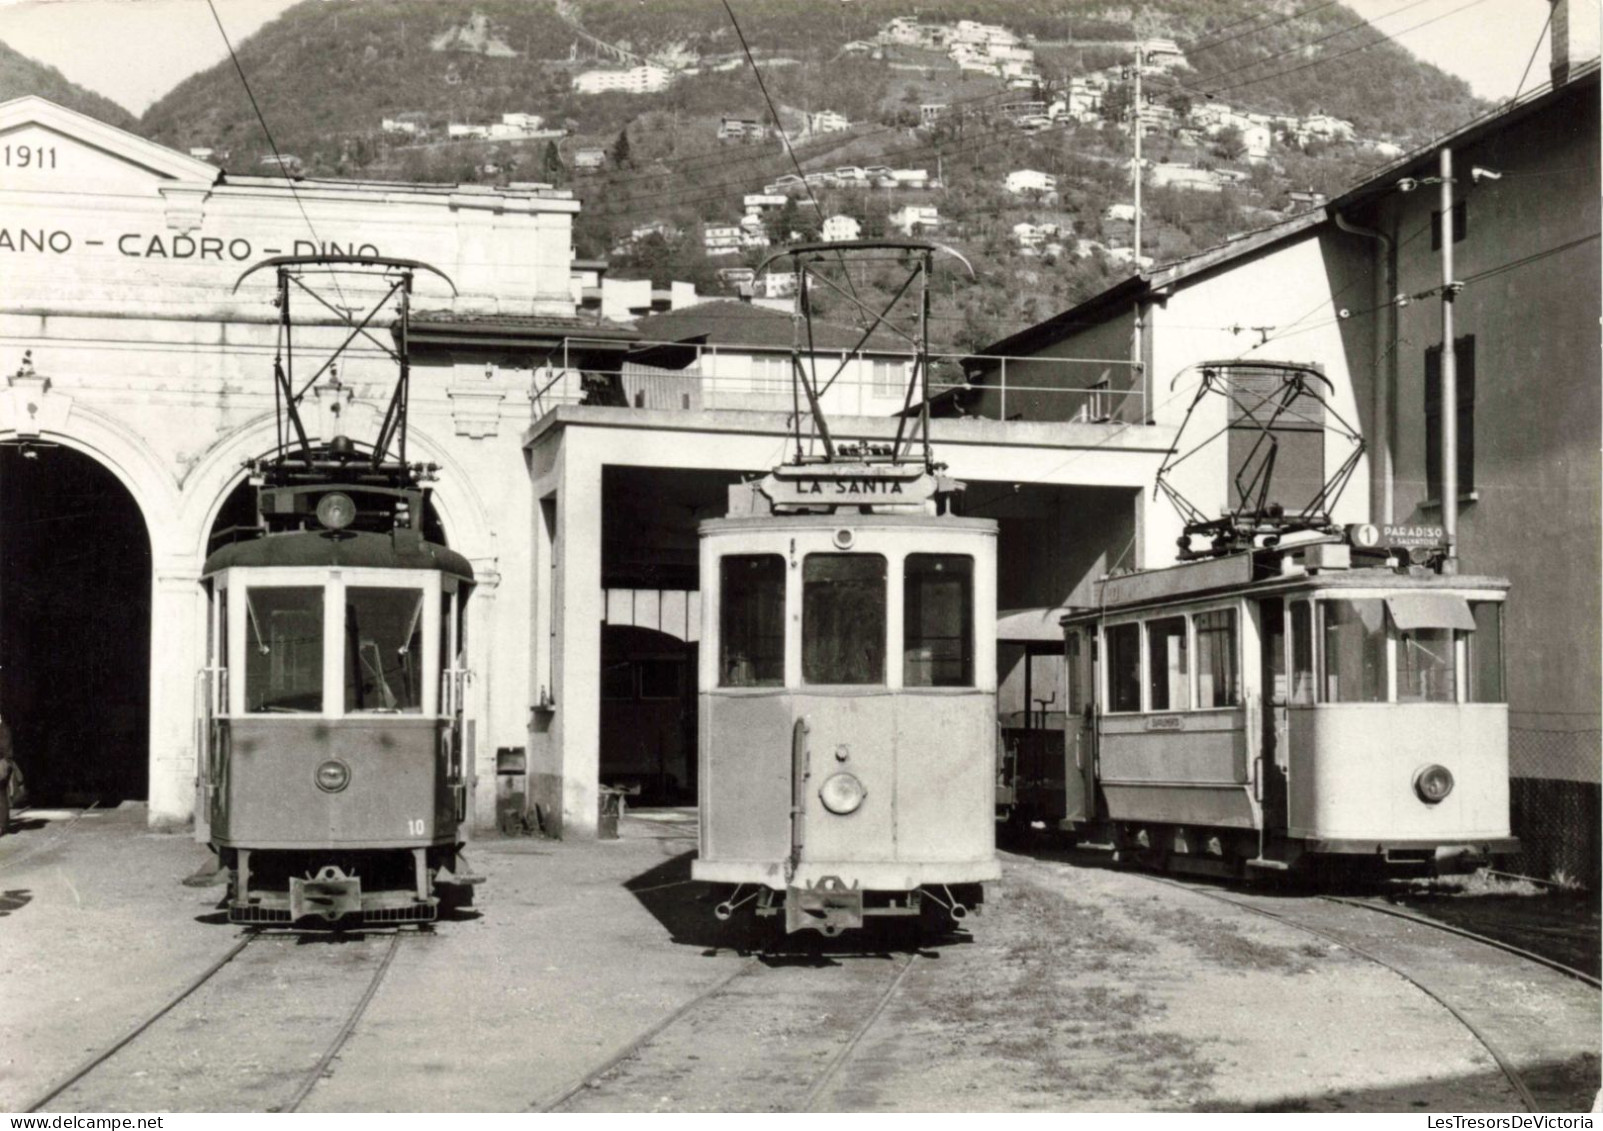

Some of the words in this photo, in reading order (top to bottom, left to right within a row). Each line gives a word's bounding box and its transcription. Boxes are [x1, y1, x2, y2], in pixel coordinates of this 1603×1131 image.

[6, 147, 55, 168] 1911
[119, 233, 252, 261] CADRO
[293, 240, 380, 256] DINO
[797, 478, 822, 494] LA
[836, 478, 904, 495] SANTA
[1364, 526, 1371, 544] 1
[1384, 526, 1443, 539] PARADISO
[408, 819, 425, 836] 10
